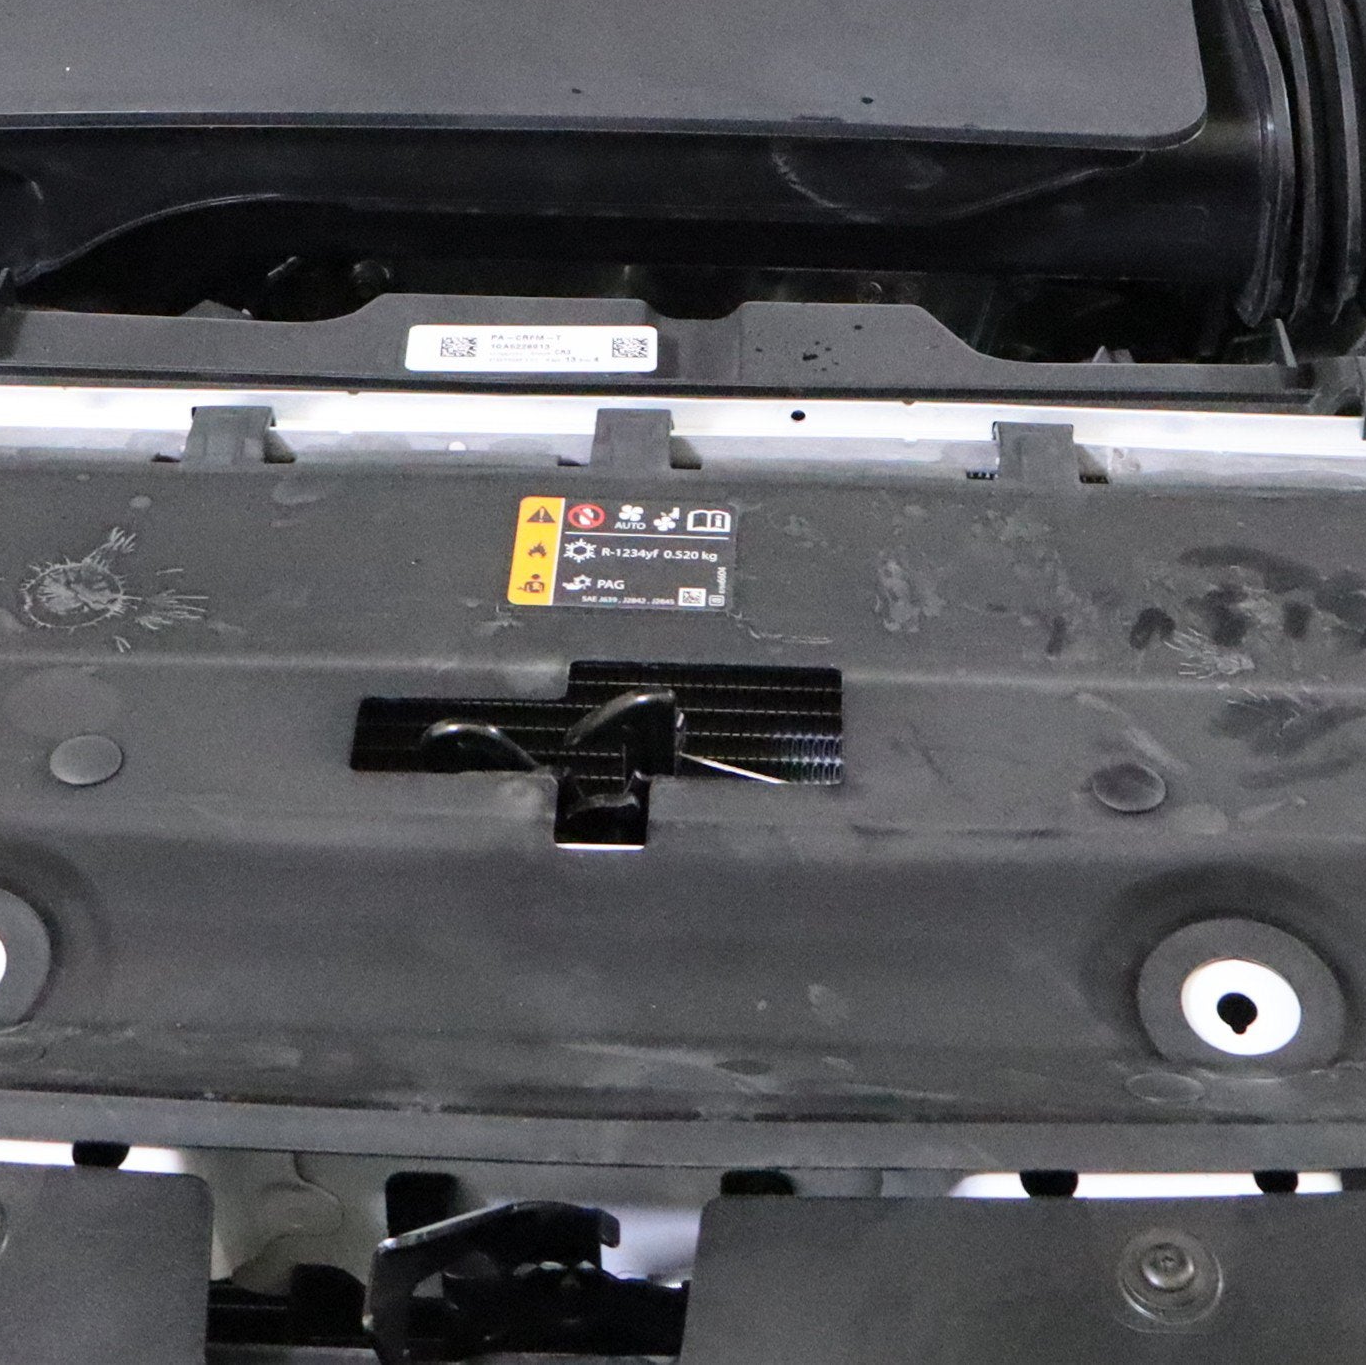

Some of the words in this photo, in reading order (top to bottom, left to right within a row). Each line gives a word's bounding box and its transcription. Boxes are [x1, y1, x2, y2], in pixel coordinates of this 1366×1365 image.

[614, 521, 647, 530] AUTO
[601, 547, 659, 561] R-1234yf
[663, 549, 699, 560] 0.520
[701, 551, 718, 563] kg
[597, 579, 625, 590] PAG
